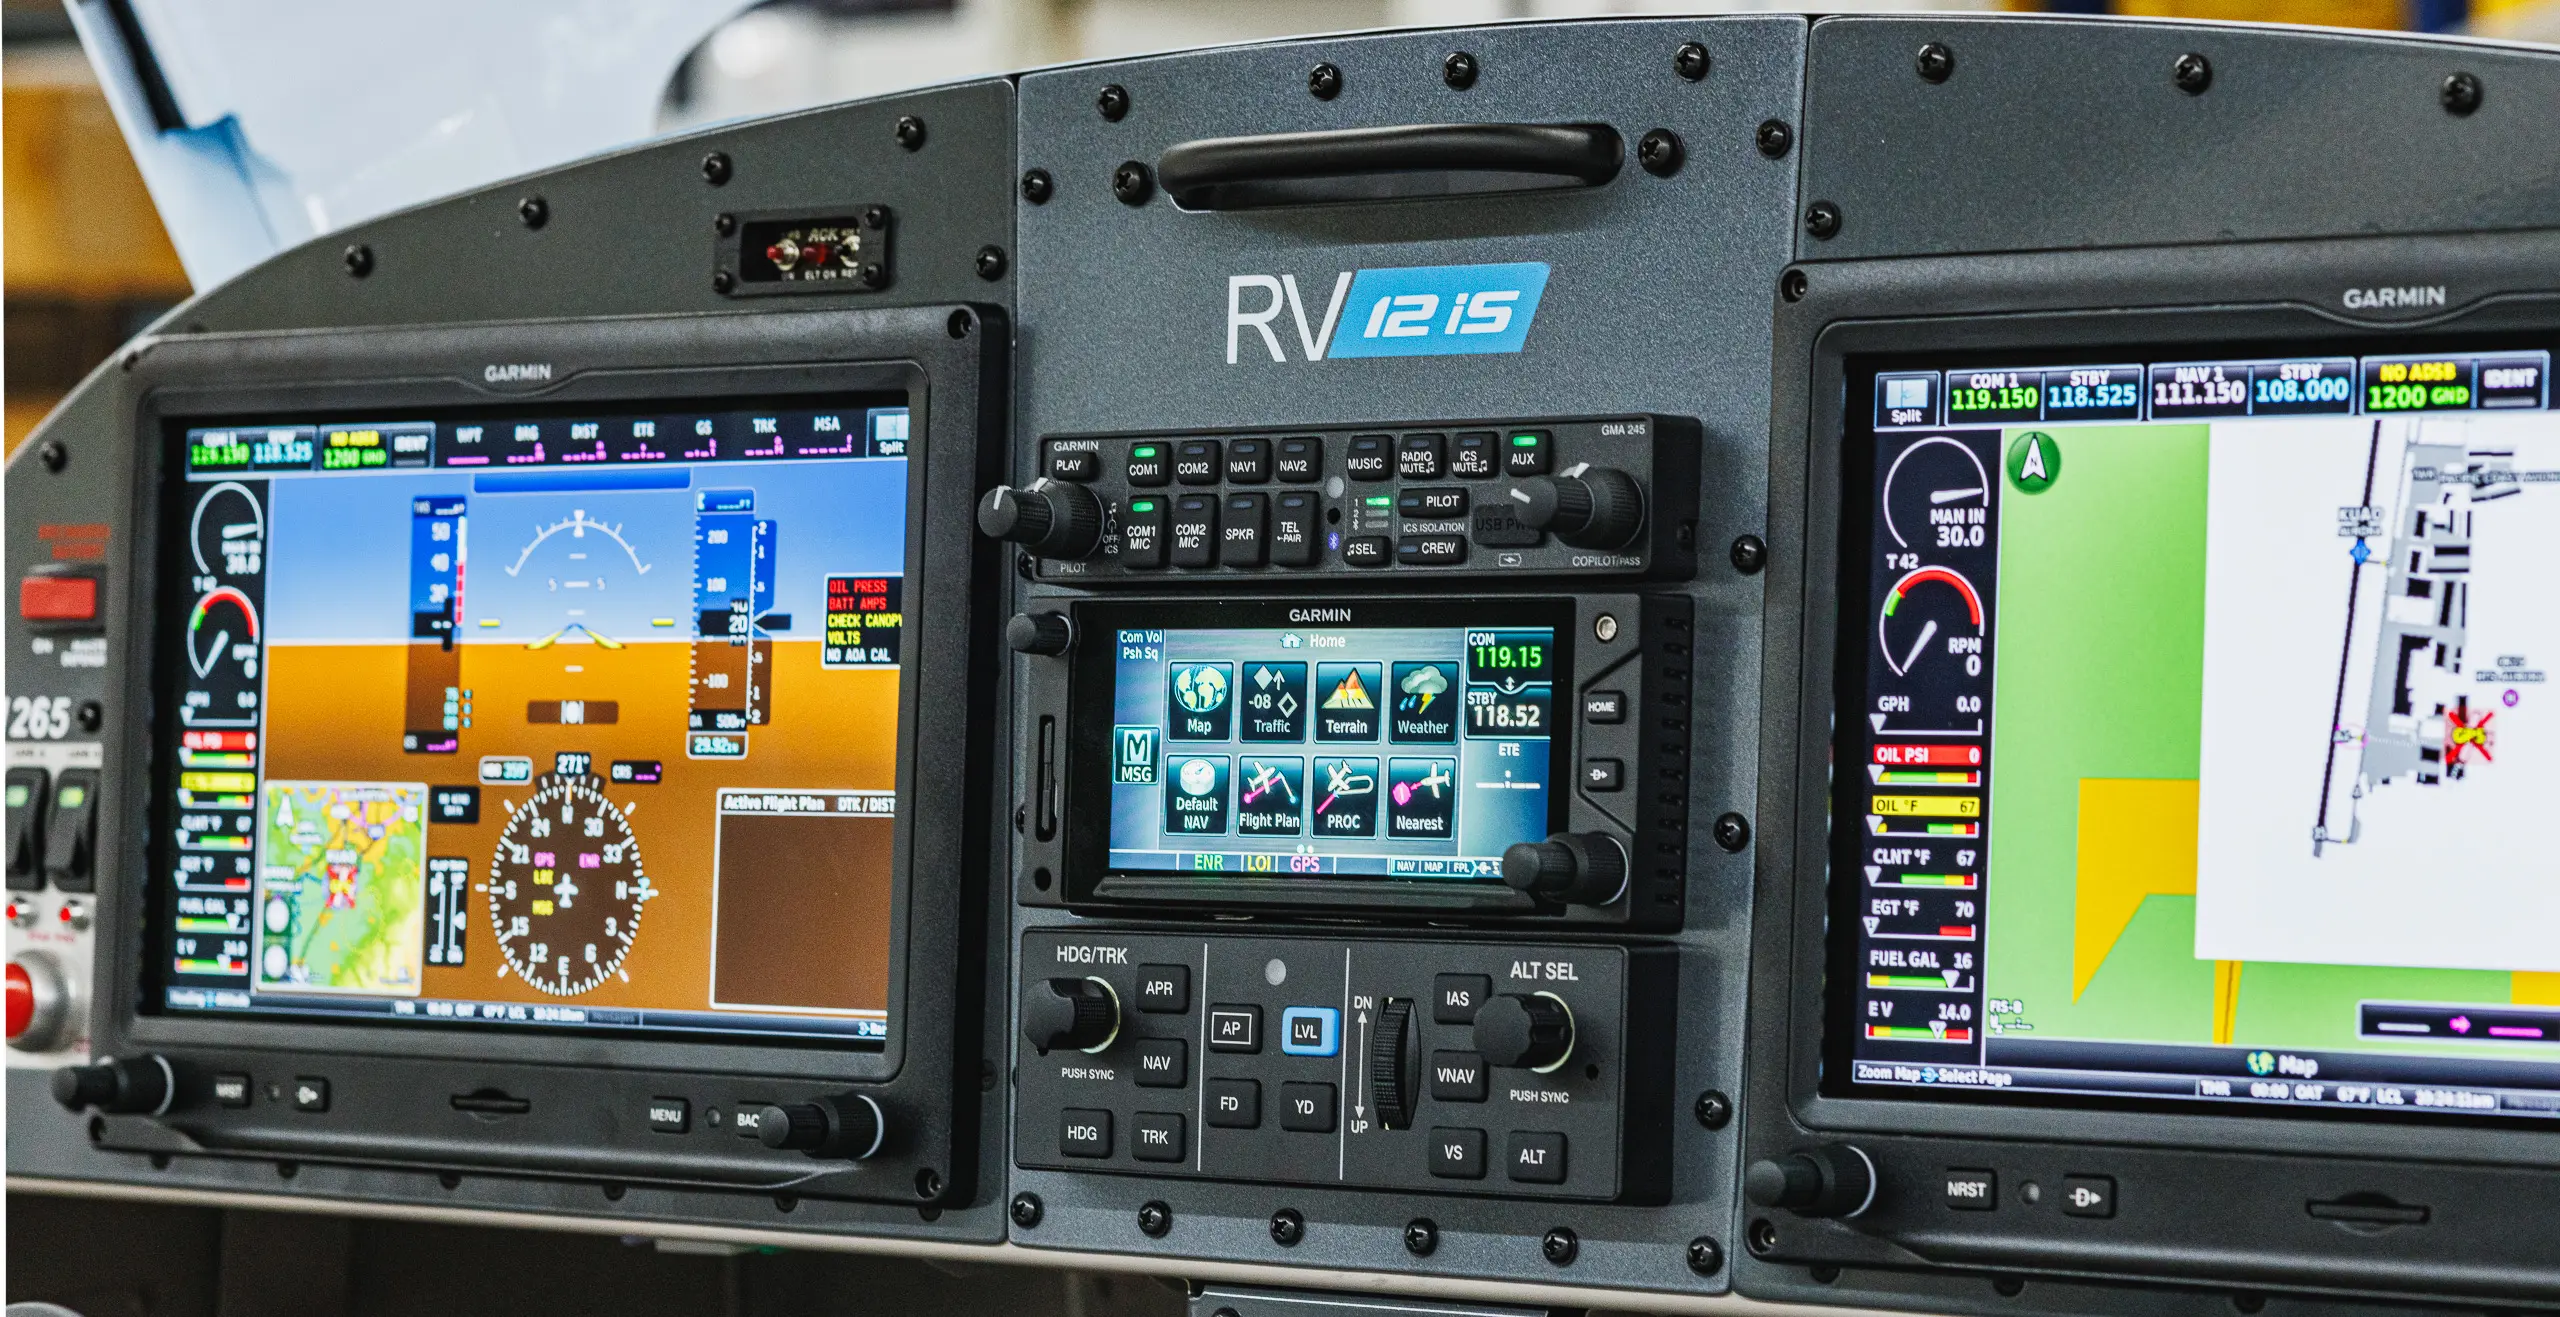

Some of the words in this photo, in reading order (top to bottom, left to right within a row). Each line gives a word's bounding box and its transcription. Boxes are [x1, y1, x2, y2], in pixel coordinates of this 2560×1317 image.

[808, 228, 838, 242] ACK
[2343, 286, 2446, 309] GARMIN
[1226, 271, 1352, 364] RV
[1364, 294, 1439, 338] 12
[485, 364, 551, 382] GARMIN
[2070, 370, 2110, 386] STBY
[2175, 367, 2210, 383] NAV
[2213, 366, 2225, 381] 1
[2280, 363, 2323, 380] STBY
[2380, 365, 2406, 381] NO
[2408, 362, 2456, 381] ADSB
[1970, 373, 2005, 388] COM
[2009, 373, 2019, 388] 1
[2049, 384, 2137, 408] 118.525
[2155, 381, 2246, 405] 111.150
[2256, 378, 2349, 403] 108.000
[2369, 385, 2427, 410] 1200
[2430, 386, 2470, 405] GND
[1952, 387, 2038, 410] 119.150
[1891, 409, 1922, 424] Split
[753, 418, 777, 434] TRK
[814, 416, 841, 432] MSA
[1601, 425, 1625, 436] GMA
[1628, 424, 1646, 435] 245
[879, 441, 905, 456] Split
[1054, 441, 1099, 452] GARMIN
[1348, 457, 1382, 470] MUSIC
[1401, 451, 1432, 462] RADIO
[1460, 451, 1476, 462] ICS
[1511, 452, 1534, 465] AUX
[1056, 460, 1081, 471] PLAY
[1129, 464, 1158, 476] COM1
[1178, 463, 1208, 474] COM2
[1230, 462, 1256, 473] NAV1
[1279, 461, 1307, 472] NAV2
[1400, 462, 1425, 473] MUTE
[1453, 462, 1478, 472] MUTE
[1426, 495, 1459, 507] PILOT
[1930, 508, 1964, 524] MAN
[1968, 508, 1986, 524] IN
[1127, 526, 1156, 538] COM1
[1176, 525, 1206, 536] COM2
[1281, 522, 1299, 533] TEL
[1403, 523, 1417, 533] ICS
[1419, 521, 1465, 533] ISOLATION
[1476, 519, 1501, 531] USB
[1225, 529, 1254, 541] SPKR
[1283, 533, 1301, 543] PAIR
[1936, 526, 1985, 547] 30.0
[1130, 538, 1151, 550] MIC
[1179, 537, 1200, 548] MIC
[1355, 543, 1376, 555] SEL
[1421, 542, 1455, 555] CREW
[1060, 563, 1086, 573] PILOT
[1572, 555, 1641, 568] COPILOT/PASS
[829, 580, 848, 593] OIL
[854, 580, 887, 593] PRESS
[828, 597, 854, 610] BATT
[860, 597, 887, 610] AMPS
[828, 613, 861, 628] CHECK
[1289, 609, 1351, 622] GARMIN
[828, 631, 860, 645] VOLTS
[1120, 631, 1143, 643] Com
[1145, 631, 1162, 643] Vol
[1310, 635, 1345, 648] Home
[1469, 634, 1495, 645] COM
[1948, 638, 1982, 654] RPM
[827, 648, 841, 662] NO
[845, 648, 866, 662] AOA
[870, 648, 891, 662] CAL
[1123, 647, 1142, 659] Psh
[1144, 648, 1158, 661] Sq
[1476, 646, 1541, 668] 119.15
[1966, 654, 1982, 677] 0
[1249, 695, 1271, 709] -08
[1467, 692, 1497, 705] STBY
[1878, 696, 1910, 712] GPH
[1956, 696, 1982, 713] 0.0
[1588, 702, 1615, 713] HOME
[1474, 705, 1540, 726] 118.52
[1187, 720, 1211, 734] Map
[1254, 720, 1290, 733] Traffic
[1326, 719, 1367, 734] Terrain
[1398, 720, 1448, 734] Weather
[1499, 743, 1520, 756] ETE
[1877, 747, 1901, 763] OIL
[1905, 747, 1929, 763] PSI
[1121, 767, 1151, 782] MSG
[724, 795, 761, 810] Active
[762, 795, 798, 813] Flight
[799, 796, 825, 812] Plan
[1176, 797, 1218, 811] Default
[1876, 800, 1897, 812] OIL
[1960, 801, 1976, 812] 67
[1184, 816, 1208, 829] NAV
[1239, 813, 1272, 829] Flight
[1275, 813, 1299, 827] Plan
[1327, 815, 1360, 829] PROC
[1396, 816, 1444, 830] Nearest
[1194, 855, 1223, 870] ENR
[1247, 856, 1271, 871] LOI
[1290, 856, 1320, 872] GPS
[1873, 848, 1911, 865] CLNT
[1956, 850, 1976, 866] 67
[1397, 861, 1415, 872] NAV
[1425, 862, 1443, 872] MAP
[1453, 862, 1470, 872] FPL
[1872, 900, 1901, 915] EGT
[1955, 901, 1974, 918] 70
[1057, 946, 1128, 964] HDG/TRK
[1870, 950, 1907, 967] FUEL
[1909, 951, 1940, 968] GAL
[1954, 953, 1973, 969] 16
[1510, 961, 1541, 980] ALT
[1545, 963, 1579, 981] SEL
[1145, 982, 1173, 996] APR
[1354, 996, 1372, 1009] DN
[1446, 991, 1469, 1007] IAS
[1868, 1001, 1879, 1017] E
[1881, 1002, 1894, 1017] V
[1938, 1004, 1971, 1021] 14.0
[1222, 1022, 1241, 1035] AP
[1295, 1024, 1317, 1039] LVL
[1143, 1056, 1171, 1070] NAV
[2278, 1055, 2319, 1078] Map
[1061, 1067, 1087, 1079] PUSH
[1089, 1068, 1115, 1081] SYNC
[1437, 1068, 1475, 1084] VNAV
[1858, 1065, 1893, 1080] Zoom
[1894, 1067, 1921, 1084] Map
[1938, 1068, 1978, 1084] Select
[1978, 1070, 2012, 1088] Page
[1220, 1097, 1238, 1110] FD
[1510, 1089, 1539, 1102] PUSH
[1541, 1091, 1569, 1104] SYNC
[1295, 1100, 1314, 1114] YD
[650, 1108, 682, 1124] MENU
[737, 1113, 759, 1128] BAC
[1068, 1127, 1097, 1141] HDG
[1351, 1120, 1368, 1134] UP
[1141, 1130, 1168, 1145] TRK
[1444, 1145, 1463, 1160] VS
[1520, 1149, 1546, 1164] ALT
[1948, 1181, 1987, 1198] NRST
